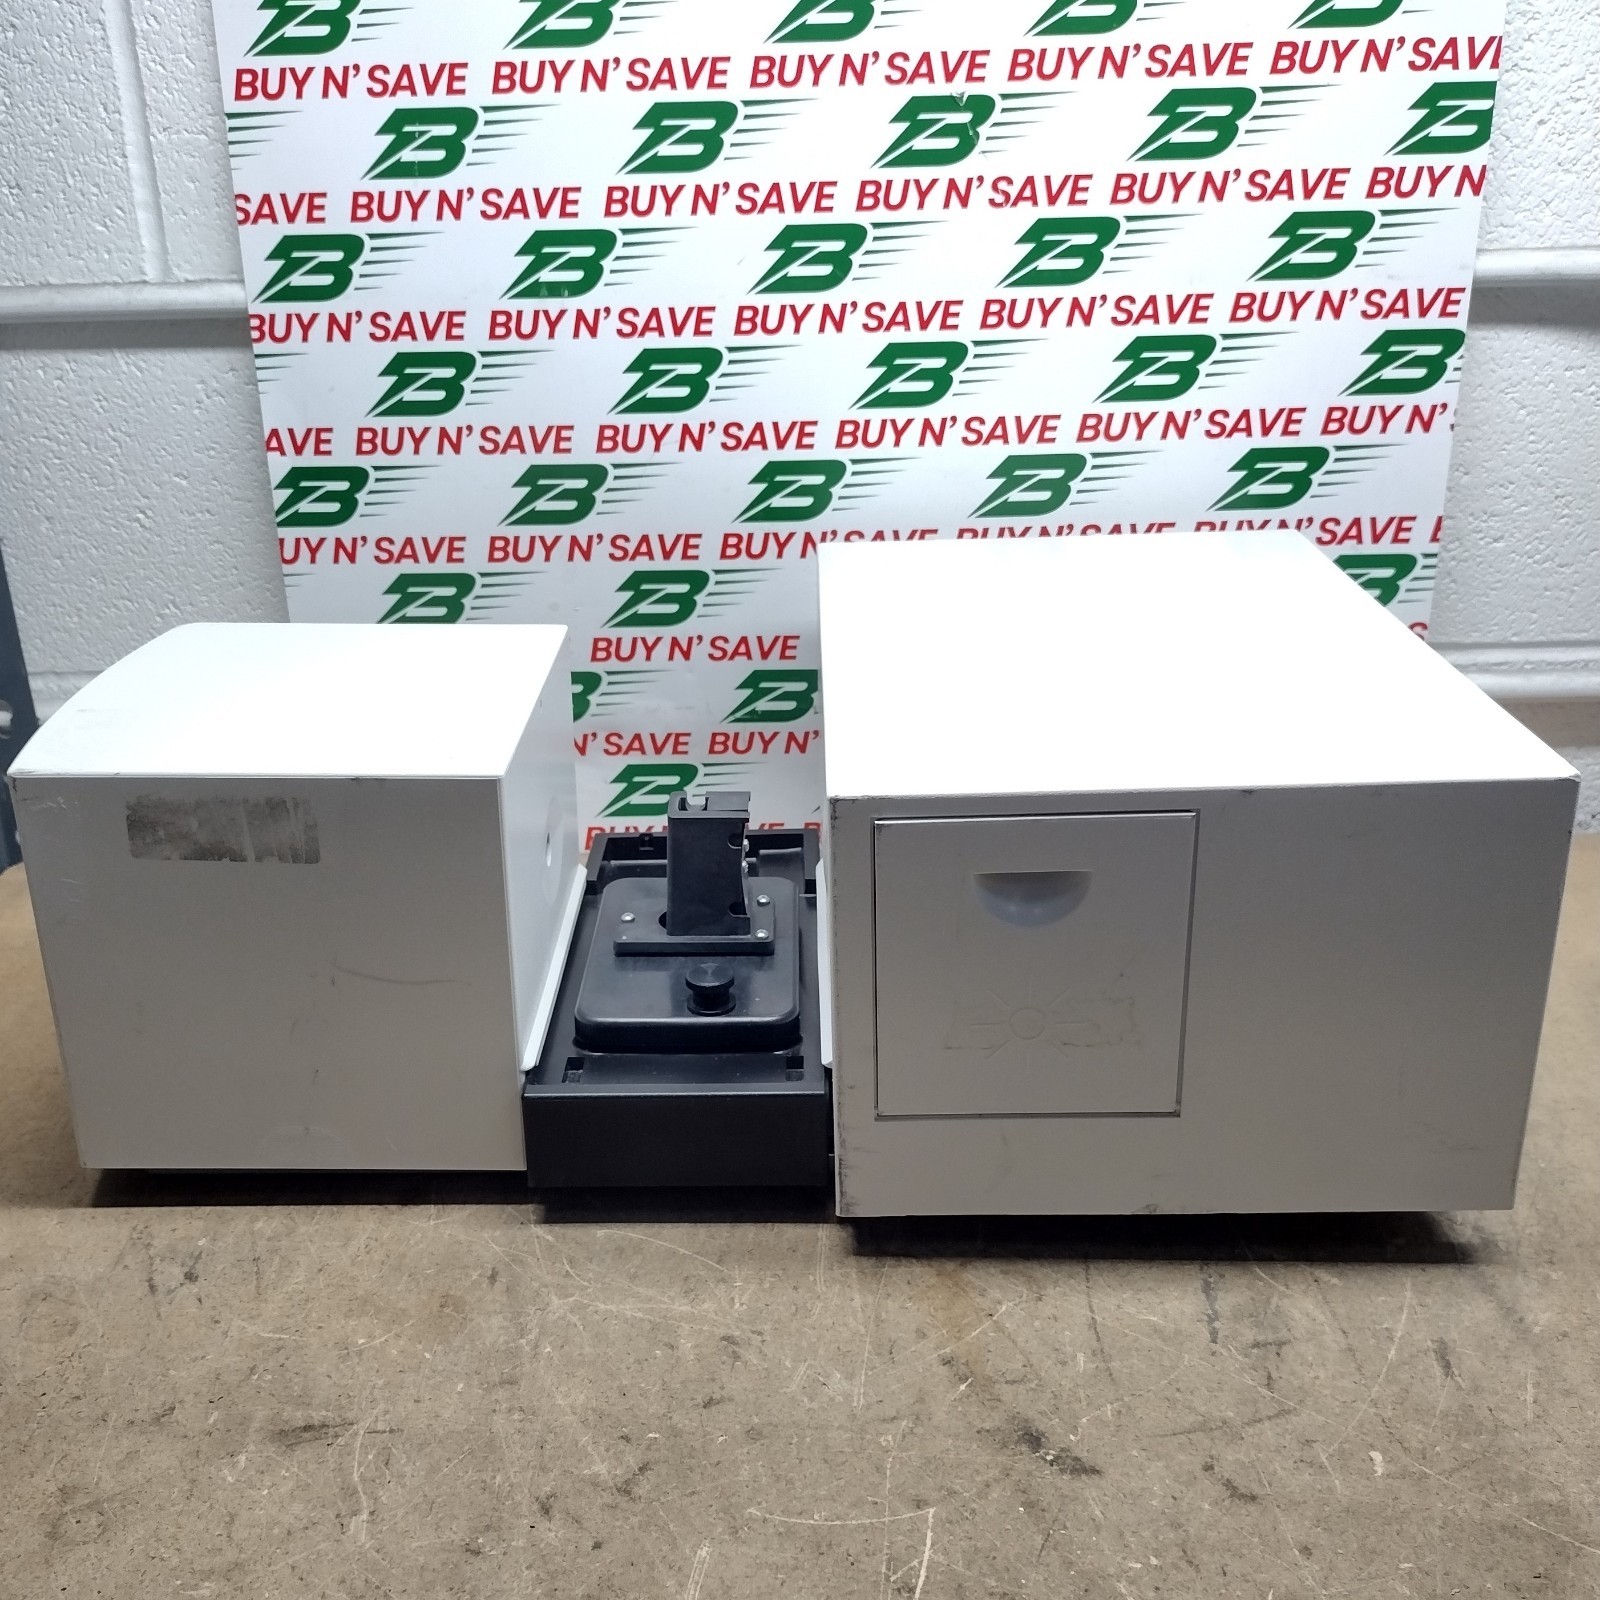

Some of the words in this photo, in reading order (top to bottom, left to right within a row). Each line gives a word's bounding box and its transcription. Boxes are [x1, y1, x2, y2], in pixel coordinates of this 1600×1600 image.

[234, 66, 315, 102] BUY
[321, 63, 361, 99] N'
[366, 62, 468, 98] SAVE
[492, 59, 574, 95] BUY
[580, 56, 621, 92] N'
[626, 56, 731, 92] SAVE
[749, 54, 834, 89] BUY
[839, 50, 880, 86] N'
[884, 49, 991, 85] SAVE
[1007, 46, 1094, 82] BUY
[1098, 43, 1142, 79] N'
[1144, 41, 1254, 79] SAVE
[1269, 39, 1359, 75] BUY
[1360, 36, 1406, 72] N'
[234, 192, 327, 226] SAVE
[350, 190, 430, 223] BUY
[436, 187, 475, 221] N'
[480, 186, 581, 221] SAVE
[604, 184, 685, 218] BUY
[690, 181, 730, 216] N'
[735, 180, 838, 215] SAVE
[855, 178, 939, 212] BUY
[943, 175, 984, 209] N'
[988, 174, 1093, 208] SAVE
[1110, 171, 1195, 205] BUY
[1198, 168, 1241, 202] N'
[1244, 167, 1351, 202] SAVE
[1366, 165, 1454, 199] BUY
[247, 312, 319, 344] BUY
[326, 310, 363, 342] N'
[369, 310, 466, 343] SAVE
[488, 309, 567, 341] BUY
[573, 306, 611, 339] N'
[616, 305, 716, 339] SAVE
[734, 303, 814, 336] BUY
[818, 300, 858, 333] N'
[862, 300, 964, 333] SAVE
[980, 297, 1063, 330] BUY
[1066, 294, 1108, 327] N'
[1110, 293, 1214, 327] SAVE
[1229, 290, 1314, 323] BUY
[1316, 287, 1359, 320] N'
[1360, 287, 1466, 320] SAVE
[355, 426, 430, 456] BUY
[437, 424, 473, 455] N'
[479, 424, 574, 455] SAVE
[595, 423, 673, 454] BUY
[678, 420, 716, 452] N'
[720, 420, 818, 452] SAVE
[835, 418, 914, 449] BUY
[918, 415, 958, 446] N'
[962, 414, 1061, 446] SAVE
[1076, 411, 1158, 443] BUY
[1161, 408, 1202, 440] N'
[1205, 407, 1309, 439] SAVE
[1320, 405, 1404, 436] BUY
[1405, 402, 1448, 433] N'
[333, 535, 368, 565] N'
[374, 536, 466, 565] SAVE
[487, 535, 562, 563] BUY
[567, 533, 604, 562] N'
[608, 533, 702, 562] SAVE
[719, 532, 796, 560] BUY
[1316, 515, 1417, 546] SAVE
[590, 636, 663, 663] BUY
[668, 634, 703, 661] N'
[708, 635, 800, 662] SAVE
[603, 731, 691, 756] SAVE
[708, 731, 779, 755] BUY
[784, 730, 820, 754] N'
